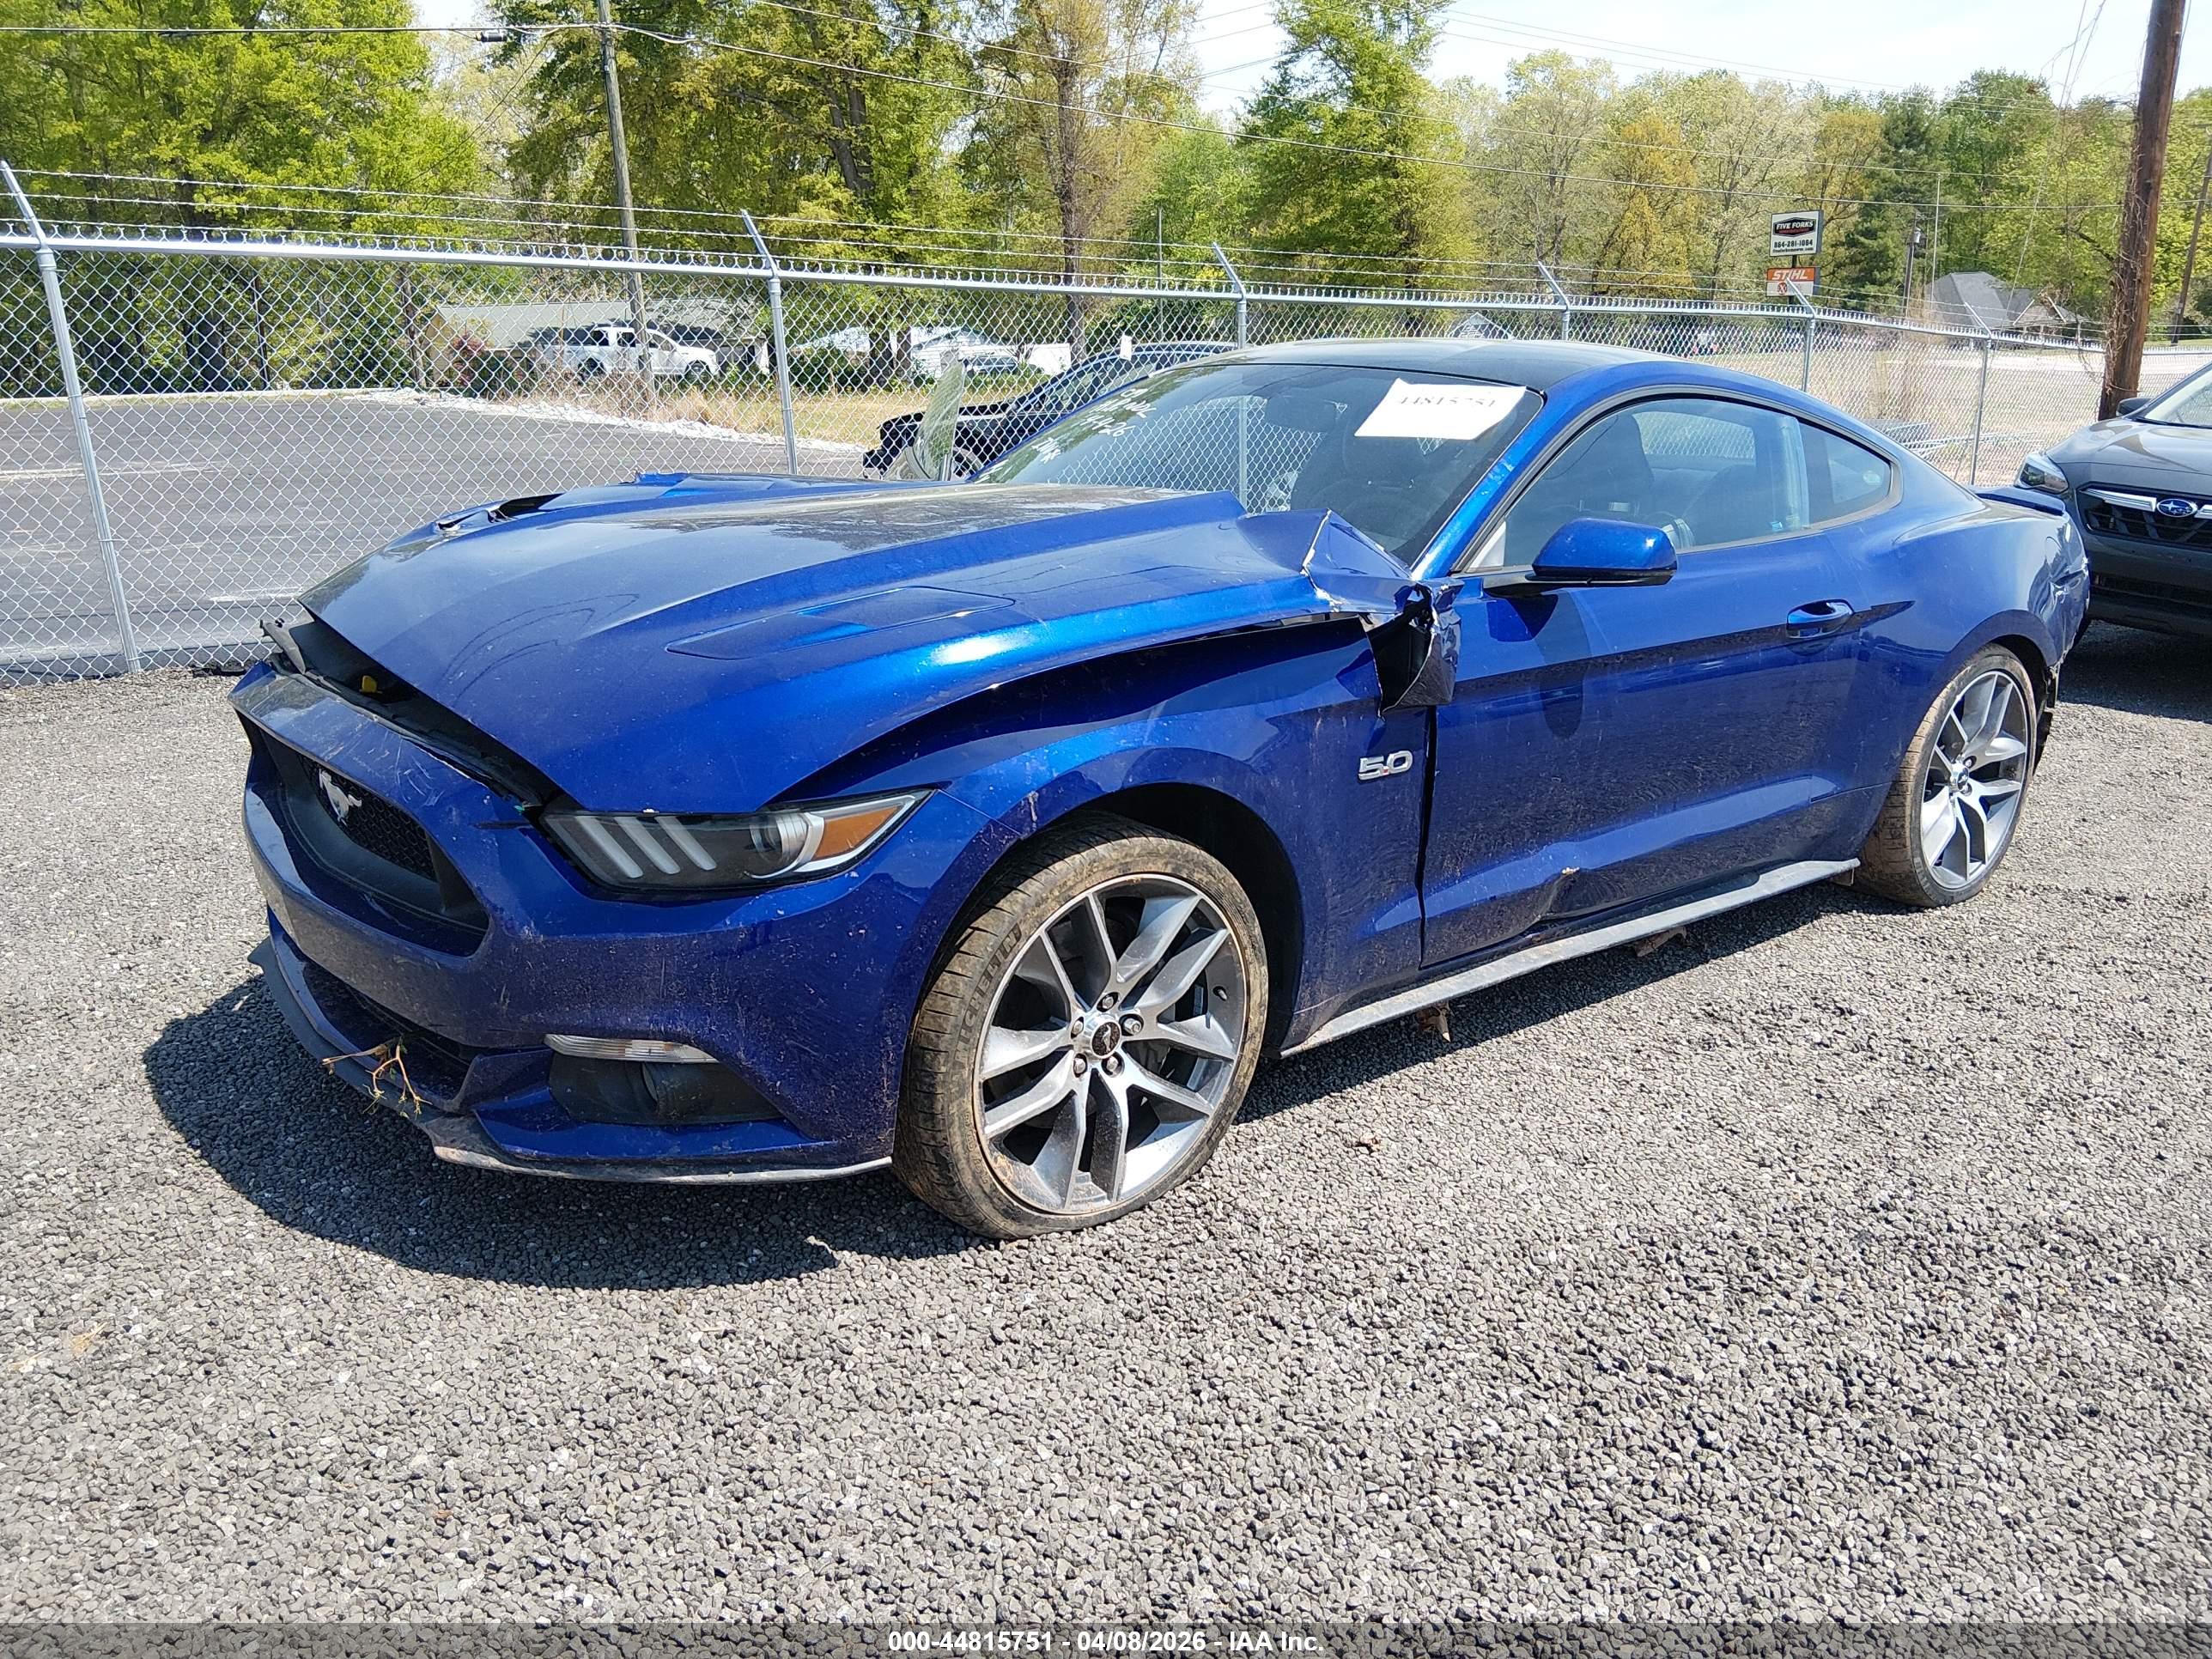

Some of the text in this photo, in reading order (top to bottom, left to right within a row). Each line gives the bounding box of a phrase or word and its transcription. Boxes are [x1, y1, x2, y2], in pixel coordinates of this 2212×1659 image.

[1771, 270, 1808, 280] STIHL
[1358, 750, 1413, 781] 5.0
[952, 922, 1024, 1066] MICHELIN
